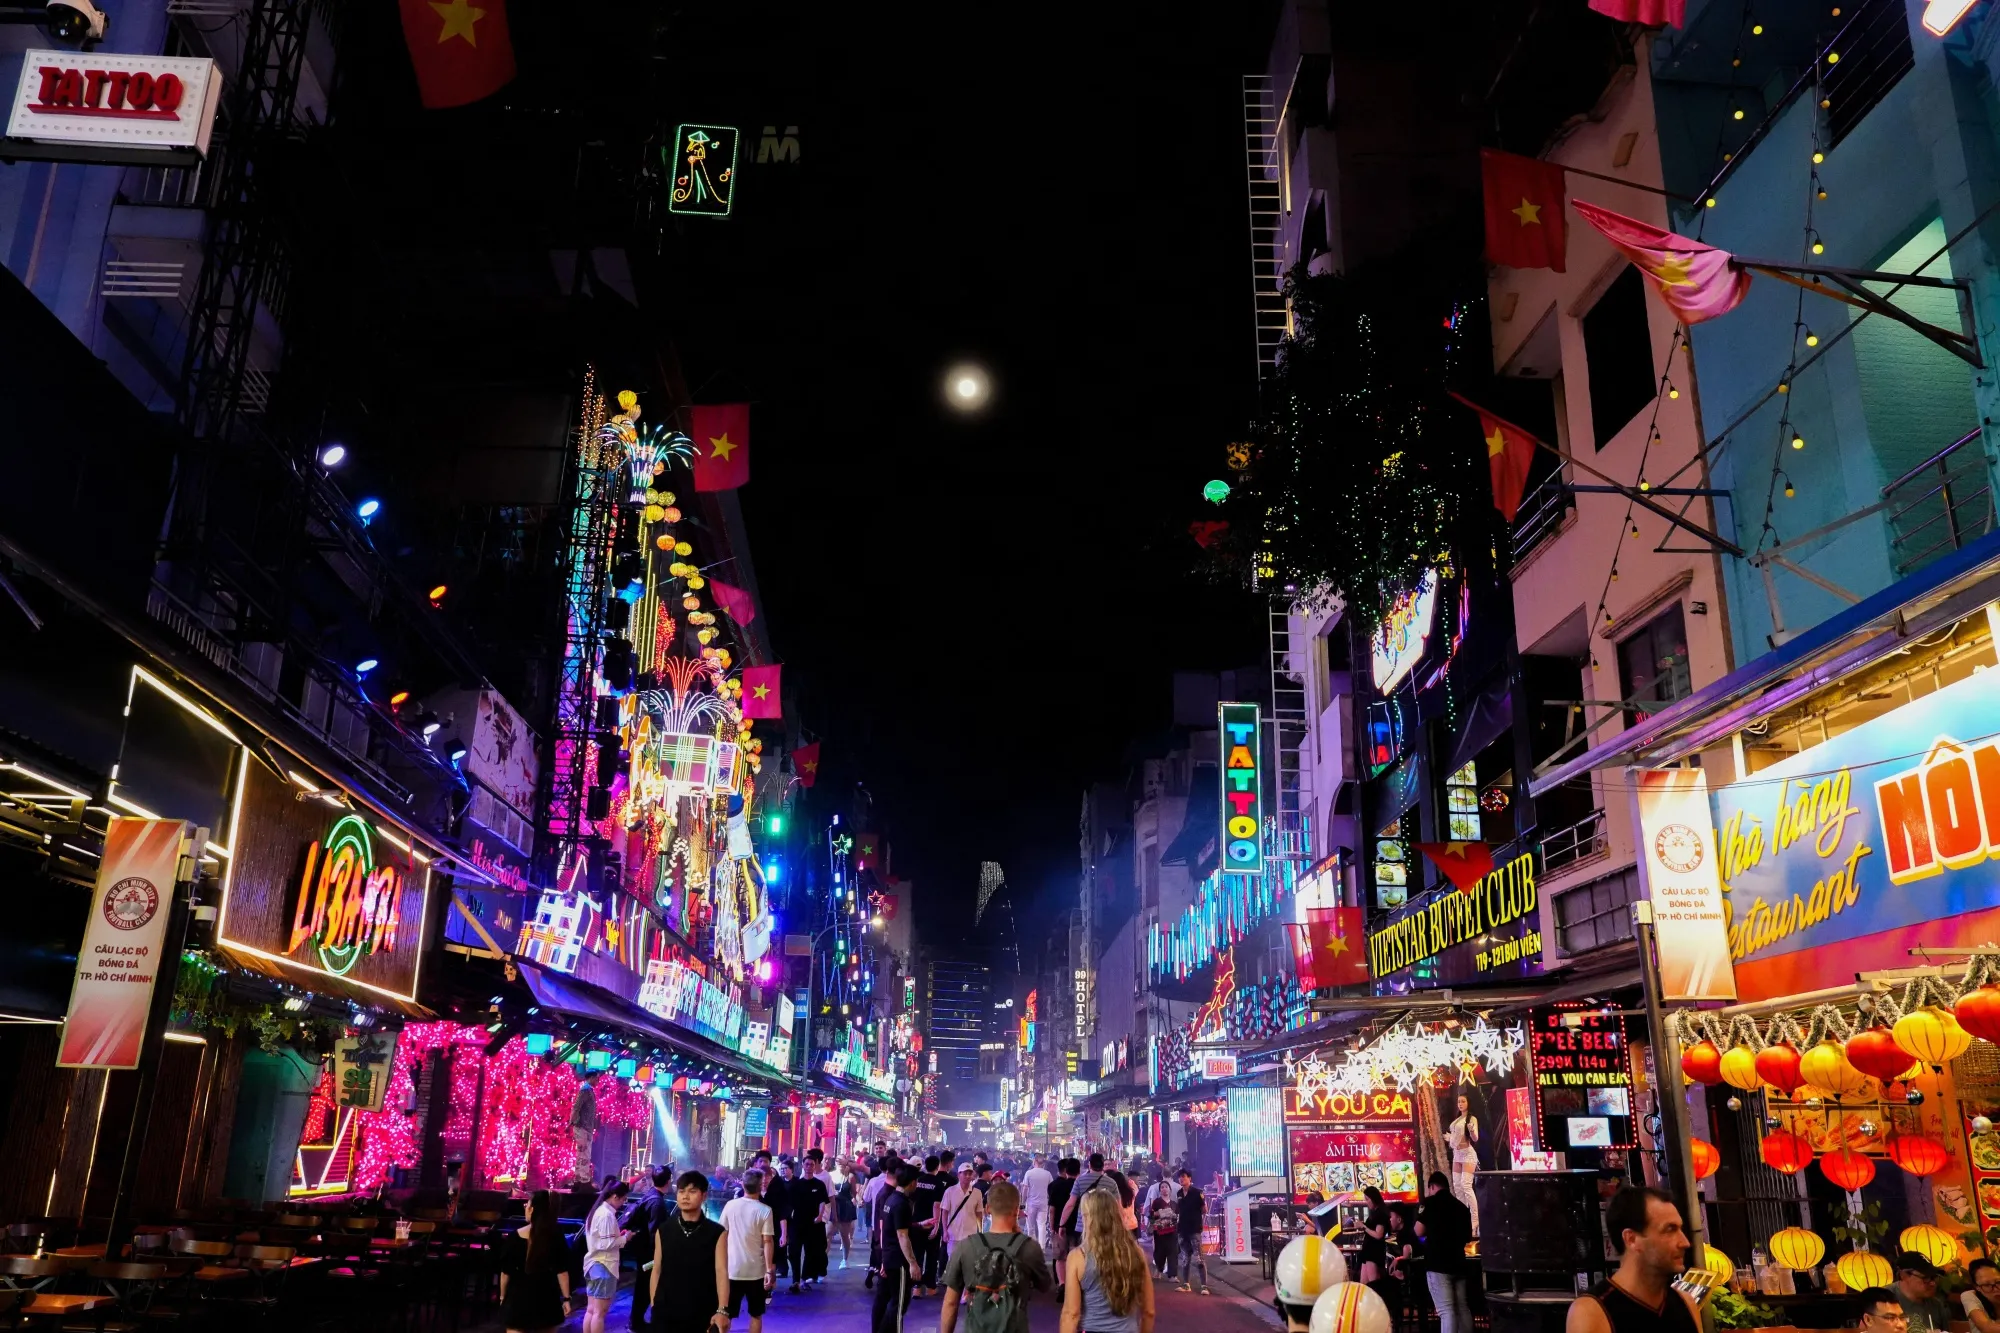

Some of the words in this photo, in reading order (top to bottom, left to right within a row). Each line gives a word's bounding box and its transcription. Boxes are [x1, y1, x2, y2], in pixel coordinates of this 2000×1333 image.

[38, 66, 184, 112] TATTOO
[1226, 723, 1257, 862] TATTOO
[1771, 764, 1860, 858] hàng
[1369, 910, 1426, 979] VIETSTAR
[1429, 877, 1484, 954] BUFFET
[1486, 852, 1537, 927] CLUB
[116, 946, 133, 956] LẠC
[135, 946, 148, 957] BỘ
[1476, 952, 1488, 972] 119
[1492, 945, 1505, 966] 121
[1505, 935, 1519, 963] BÙI
[1520, 928, 1541, 957] VIÊN
[98, 958, 124, 968] BÓNG
[126, 958, 139, 969] ĐÁ
[1075, 970, 1086, 979] 99
[80, 972, 91, 980] TP.
[94, 971, 108, 981] HỒ
[110, 972, 126, 982] CHÍ
[128, 974, 152, 983] MINH
[1076, 982, 1086, 1037] HOTEL
[1208, 1060, 1233, 1073] Tattoo
[1539, 1056, 1573, 1069] 299K
[1540, 1073, 1559, 1085] ALL
[1562, 1073, 1583, 1085] YOU
[1586, 1073, 1607, 1084] CAN
[1314, 1094, 1367, 1116] YOU
[1235, 1208, 1245, 1253] TATTOO
